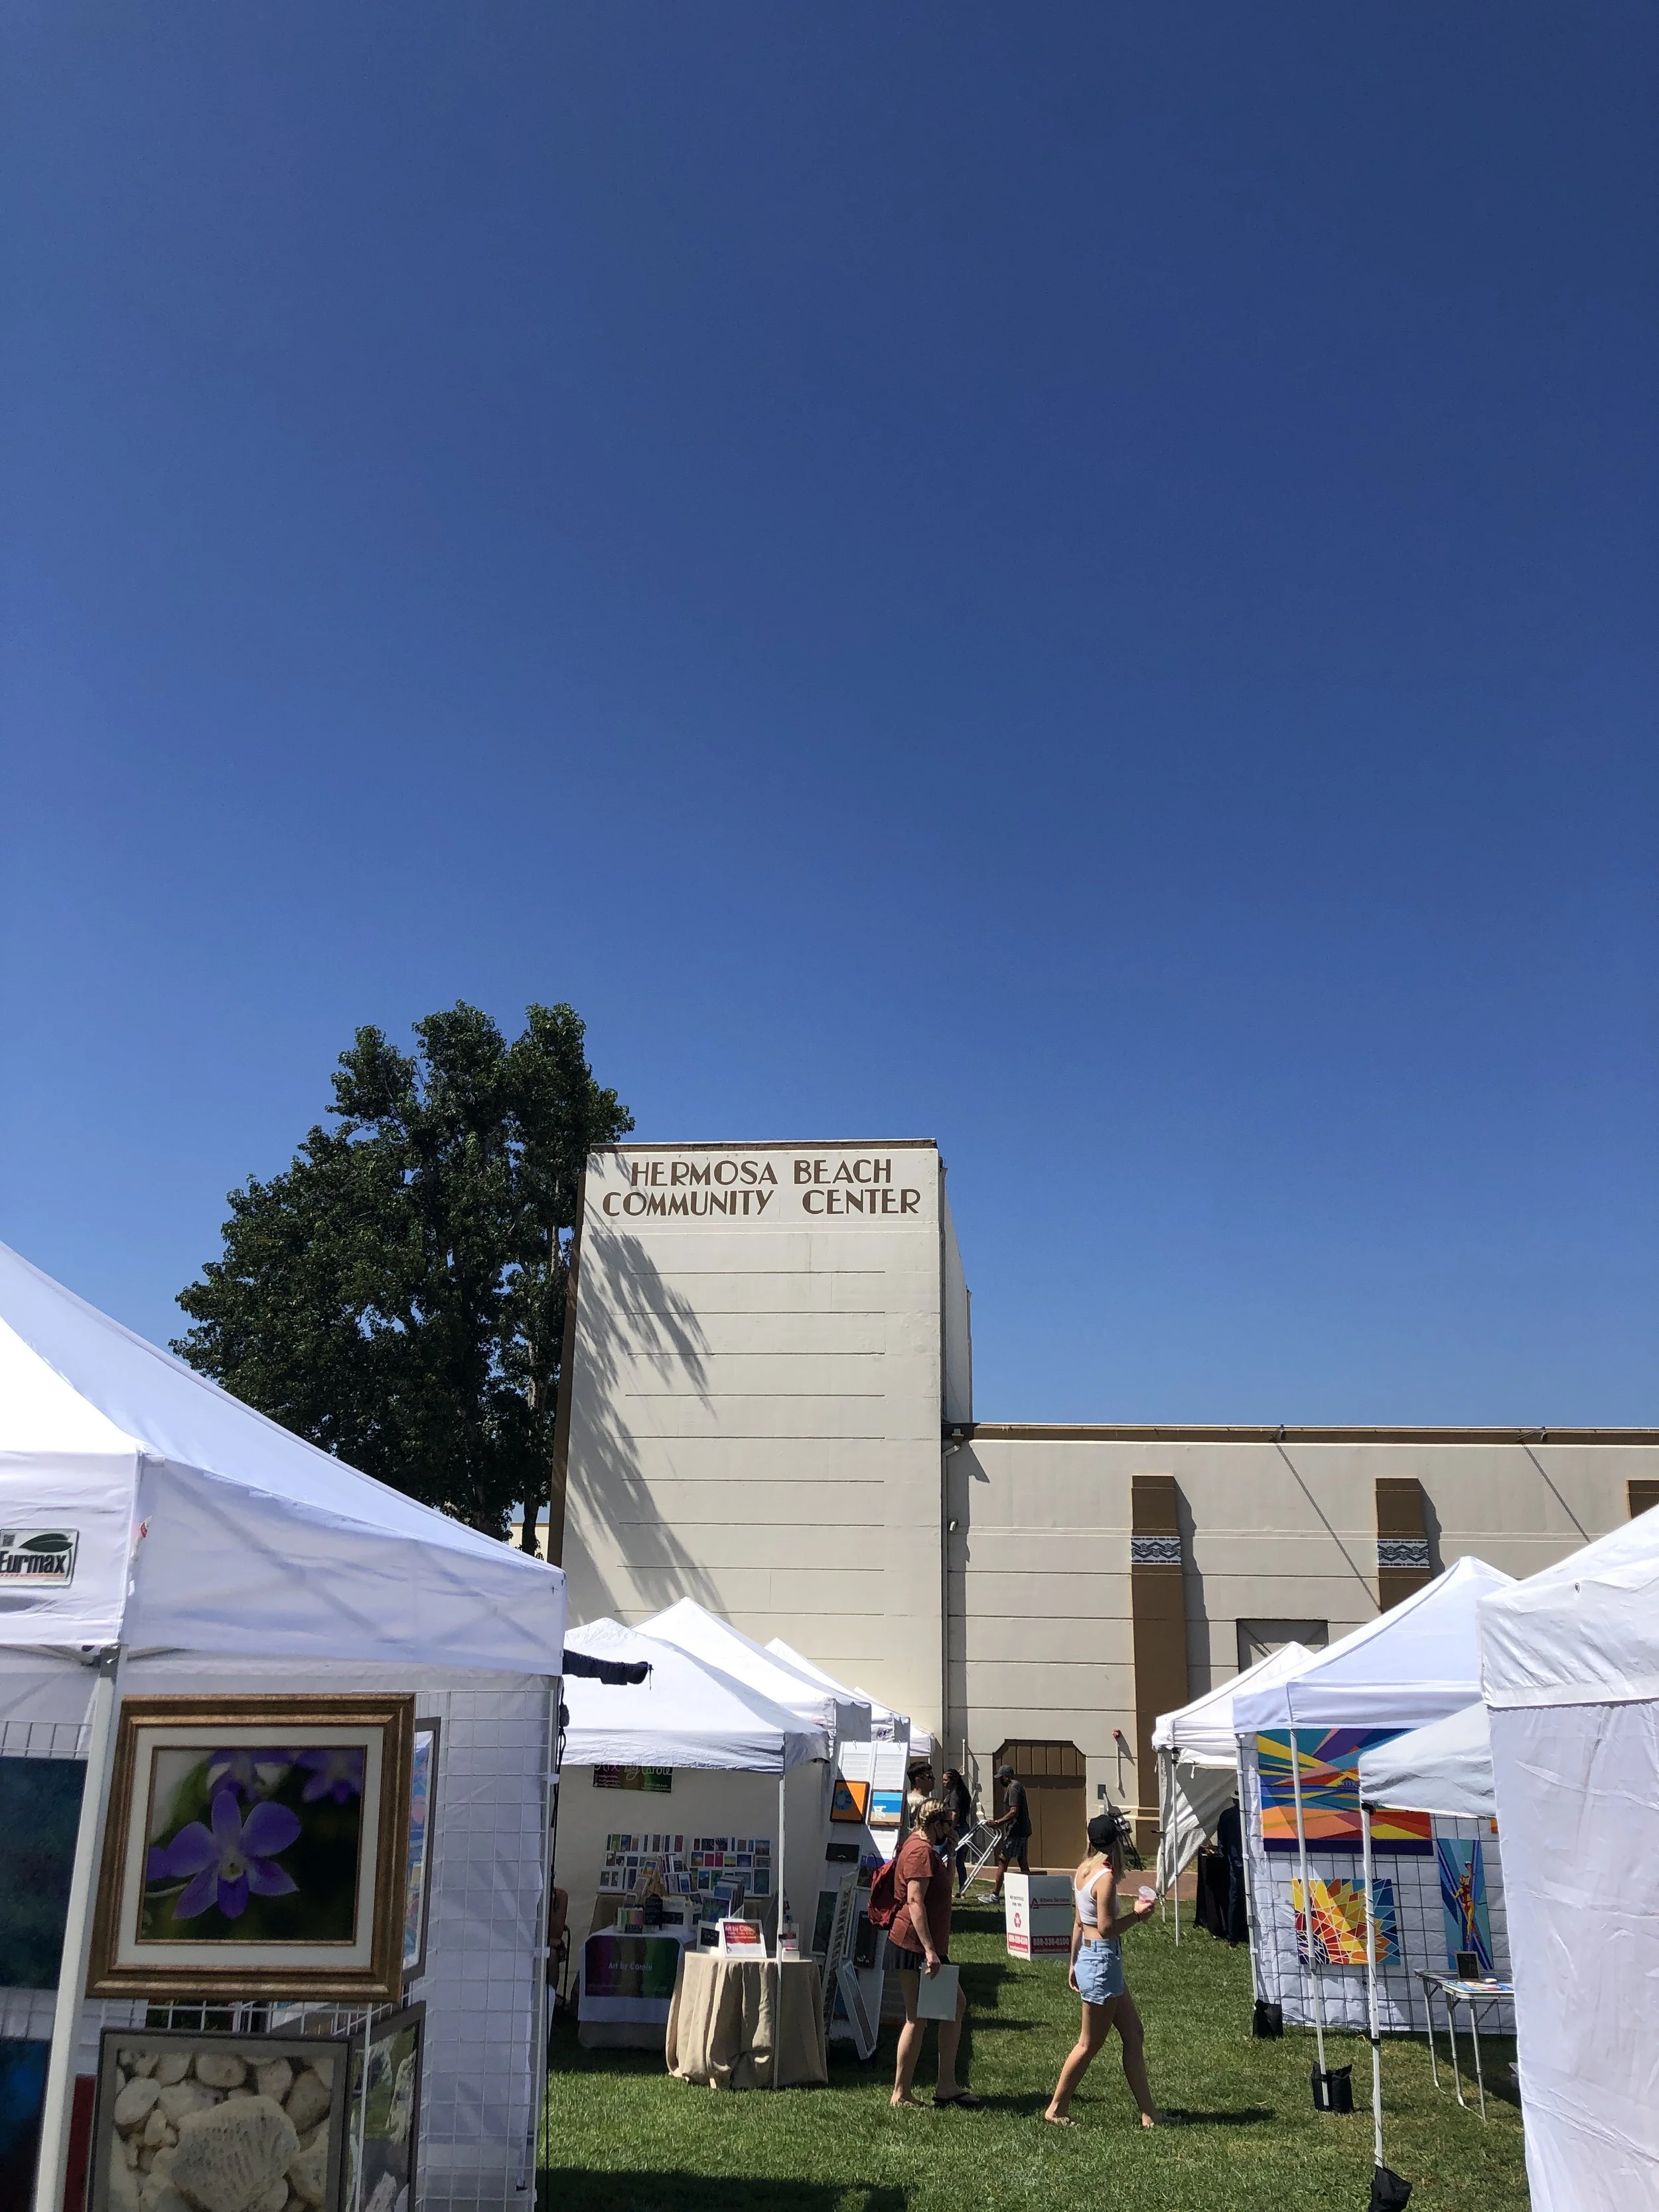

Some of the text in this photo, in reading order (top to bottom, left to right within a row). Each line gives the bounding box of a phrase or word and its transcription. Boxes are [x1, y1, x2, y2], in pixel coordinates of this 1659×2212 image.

[630, 1159, 891, 1187] HERMOSA BEACH
[602, 1189, 921, 1217] COMMUNITY CENTER
[0, 1550, 67, 1573] Eurmax
